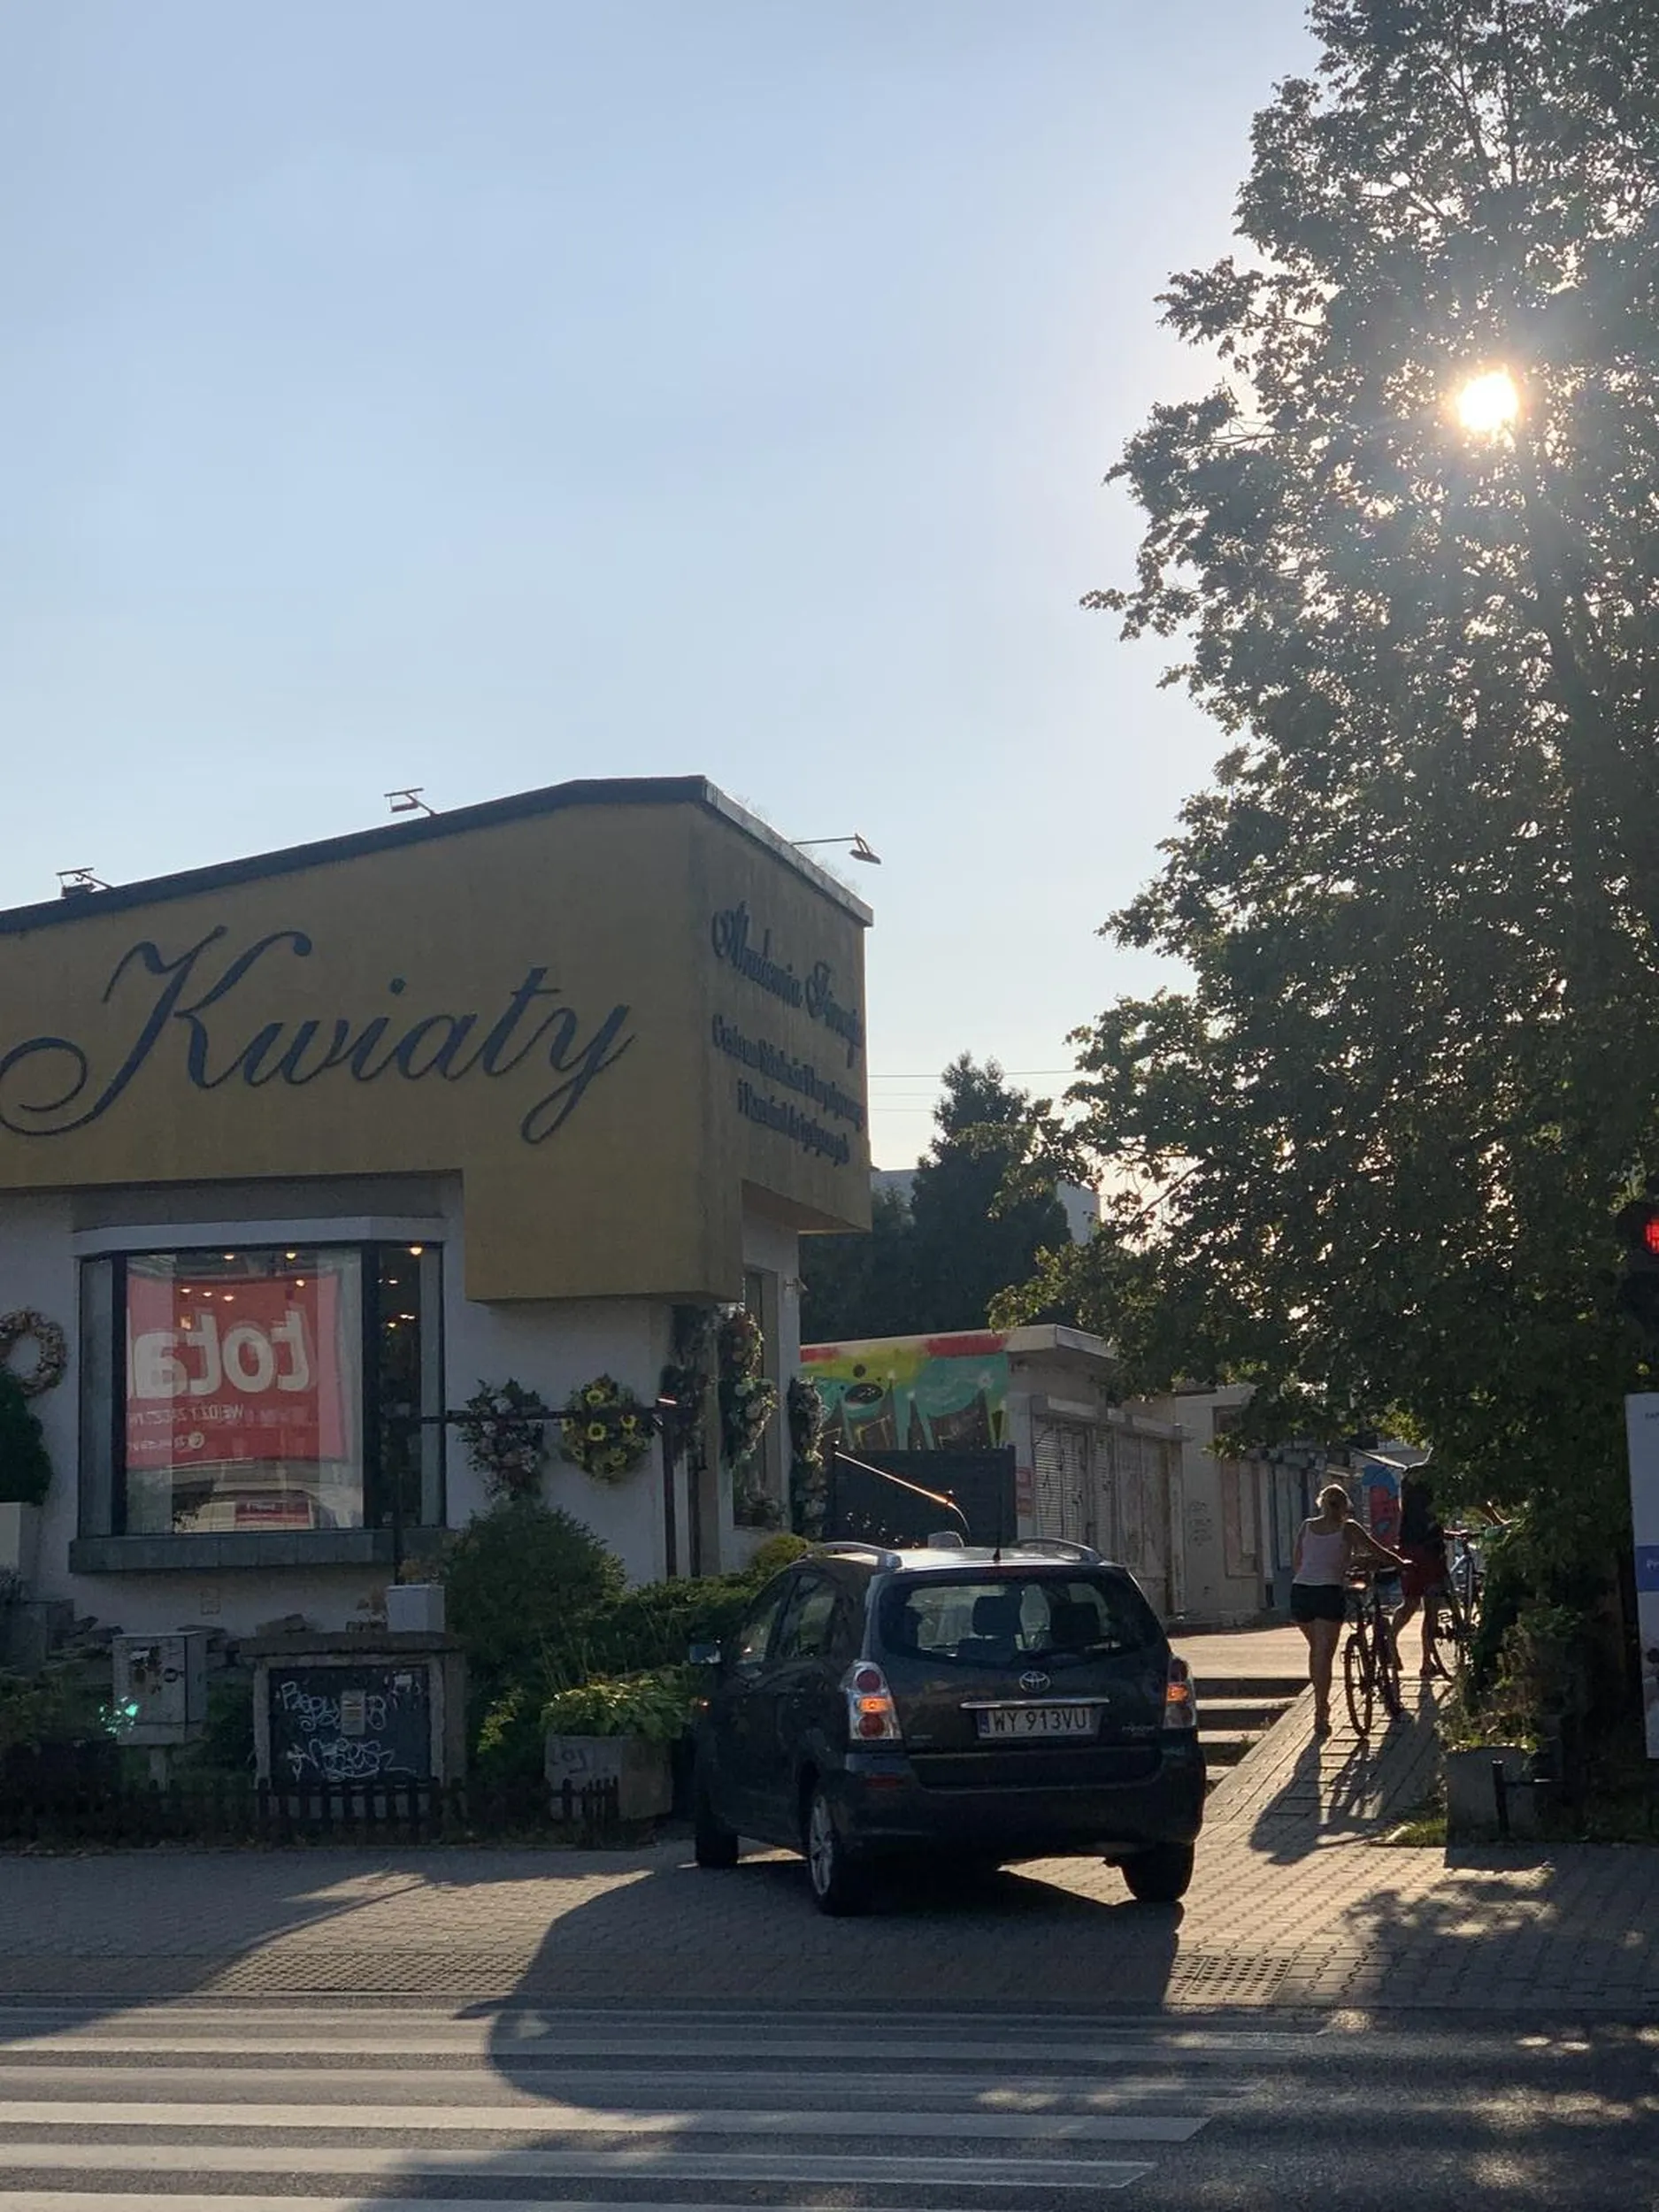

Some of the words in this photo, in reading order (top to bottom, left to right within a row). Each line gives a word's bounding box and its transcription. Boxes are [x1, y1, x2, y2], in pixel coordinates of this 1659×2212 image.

[0, 925, 634, 1144] Kwiaty
[993, 1712, 1018, 1732] WY
[1025, 1709, 1087, 1730] 913VU
